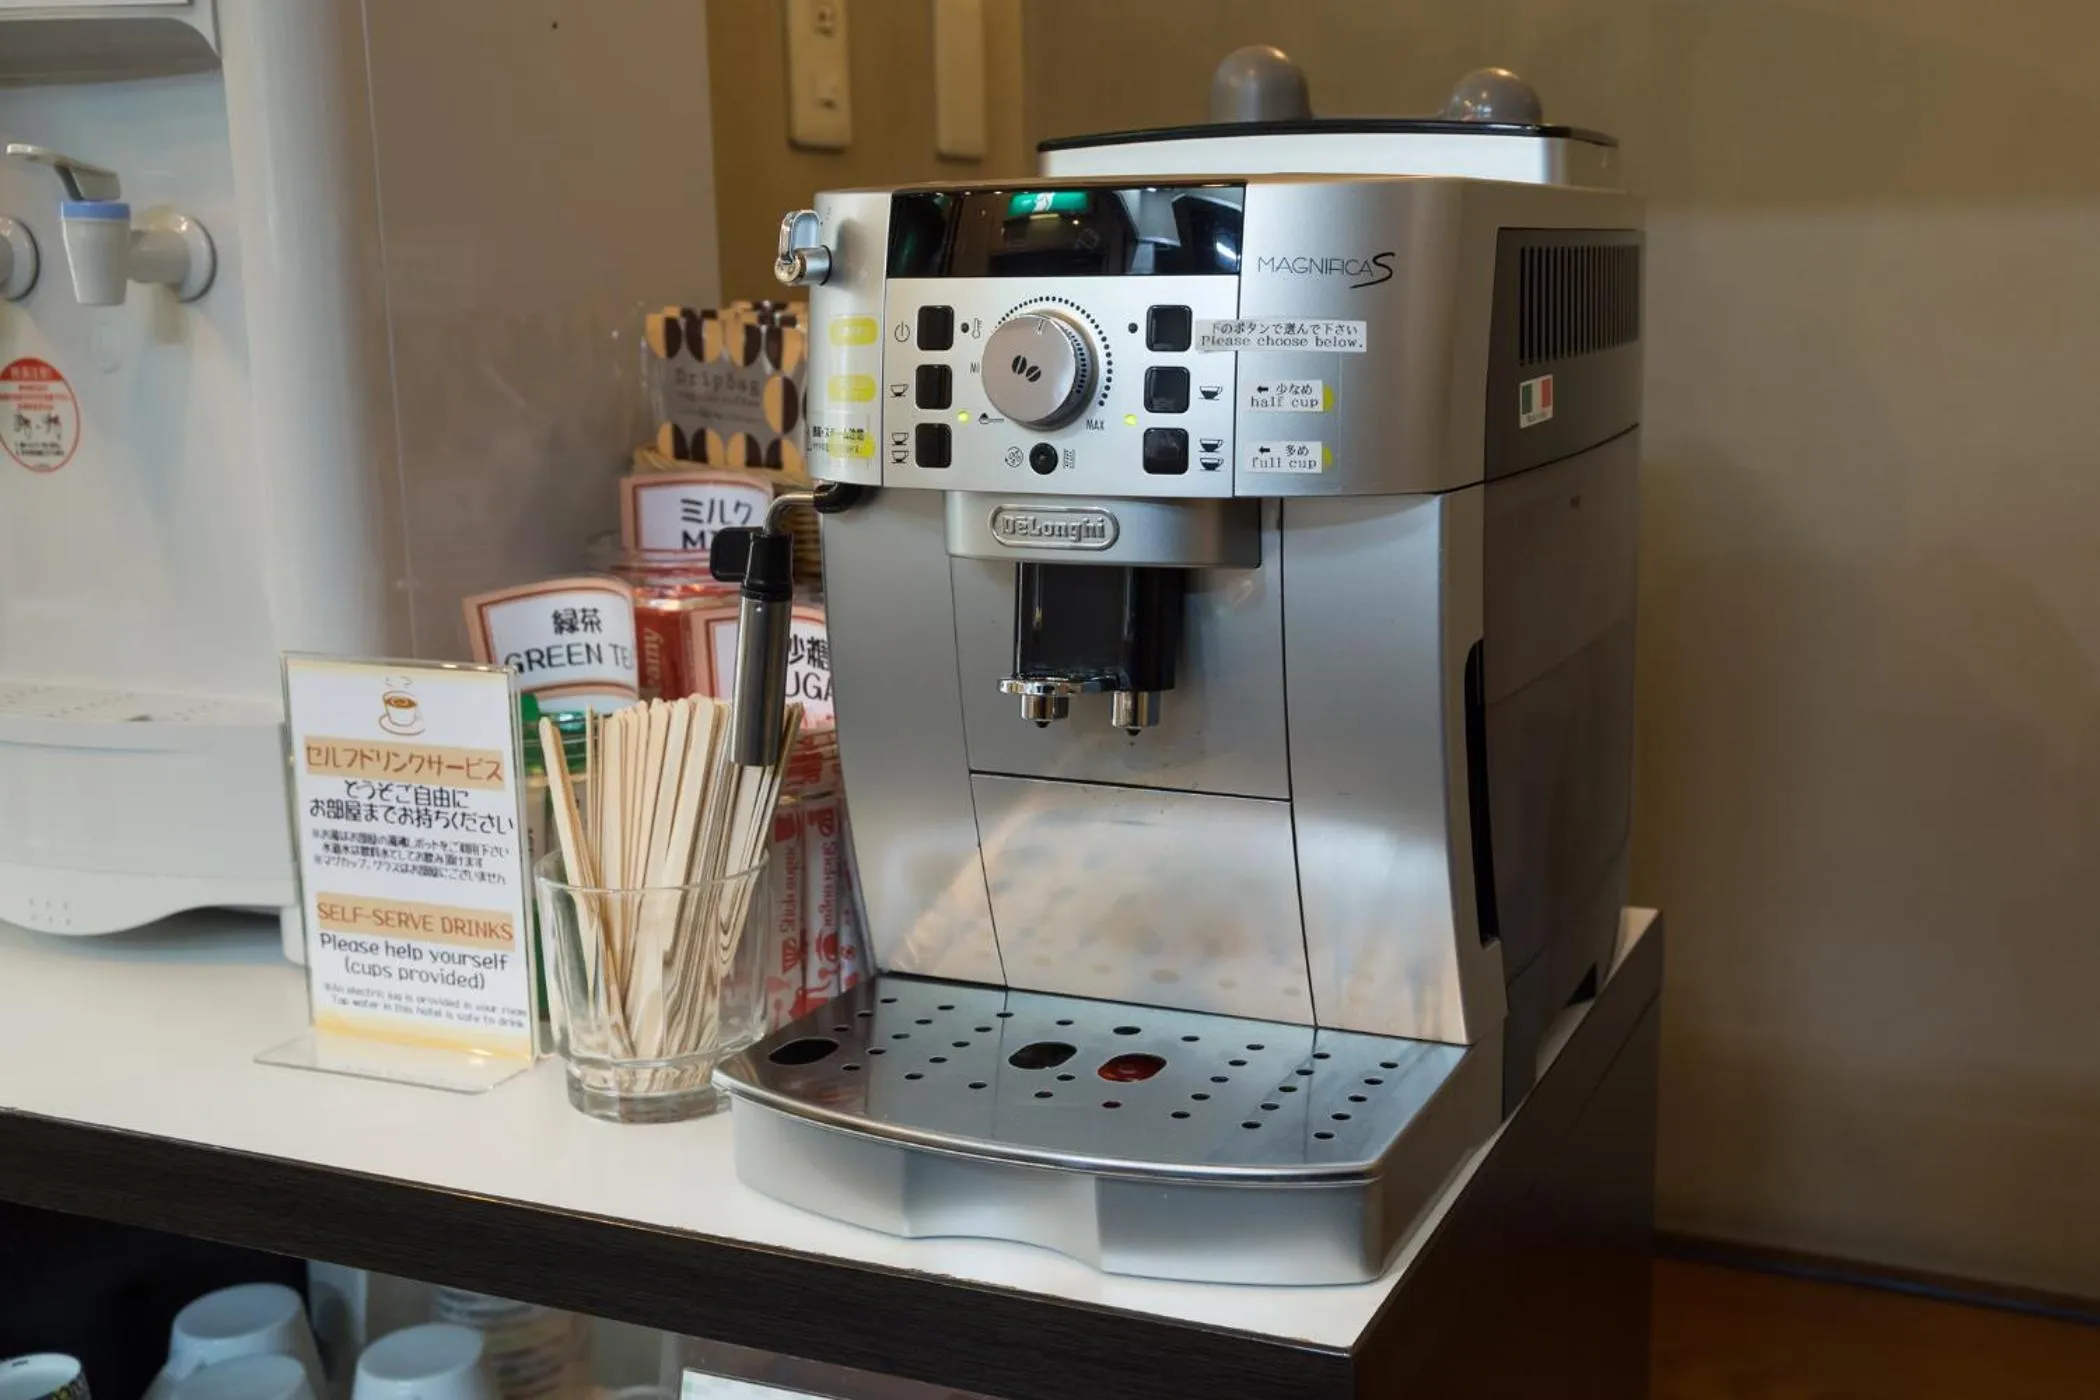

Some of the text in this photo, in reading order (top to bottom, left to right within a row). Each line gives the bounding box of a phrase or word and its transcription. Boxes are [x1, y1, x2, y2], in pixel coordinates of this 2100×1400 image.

[1201, 335, 1364, 348] Please choose below.
[1250, 396, 1320, 410] half cup
[1276, 383, 1313, 395] 少なめ
[1086, 420, 1105, 431] MAX
[1251, 457, 1317, 470] full cup
[1285, 444, 1310, 456] 多め
[681, 498, 754, 526] ミルク
[552, 607, 603, 636] 緑茶
[504, 642, 603, 674] GREEN
[306, 745, 504, 782] セルフドリンクサービス
[310, 798, 514, 835] お部屋までお持ちください
[316, 901, 514, 942] SELF-SERVE DRINKS
[320, 932, 509, 971] Please help yourself
[344, 956, 486, 990] (cups provided)
